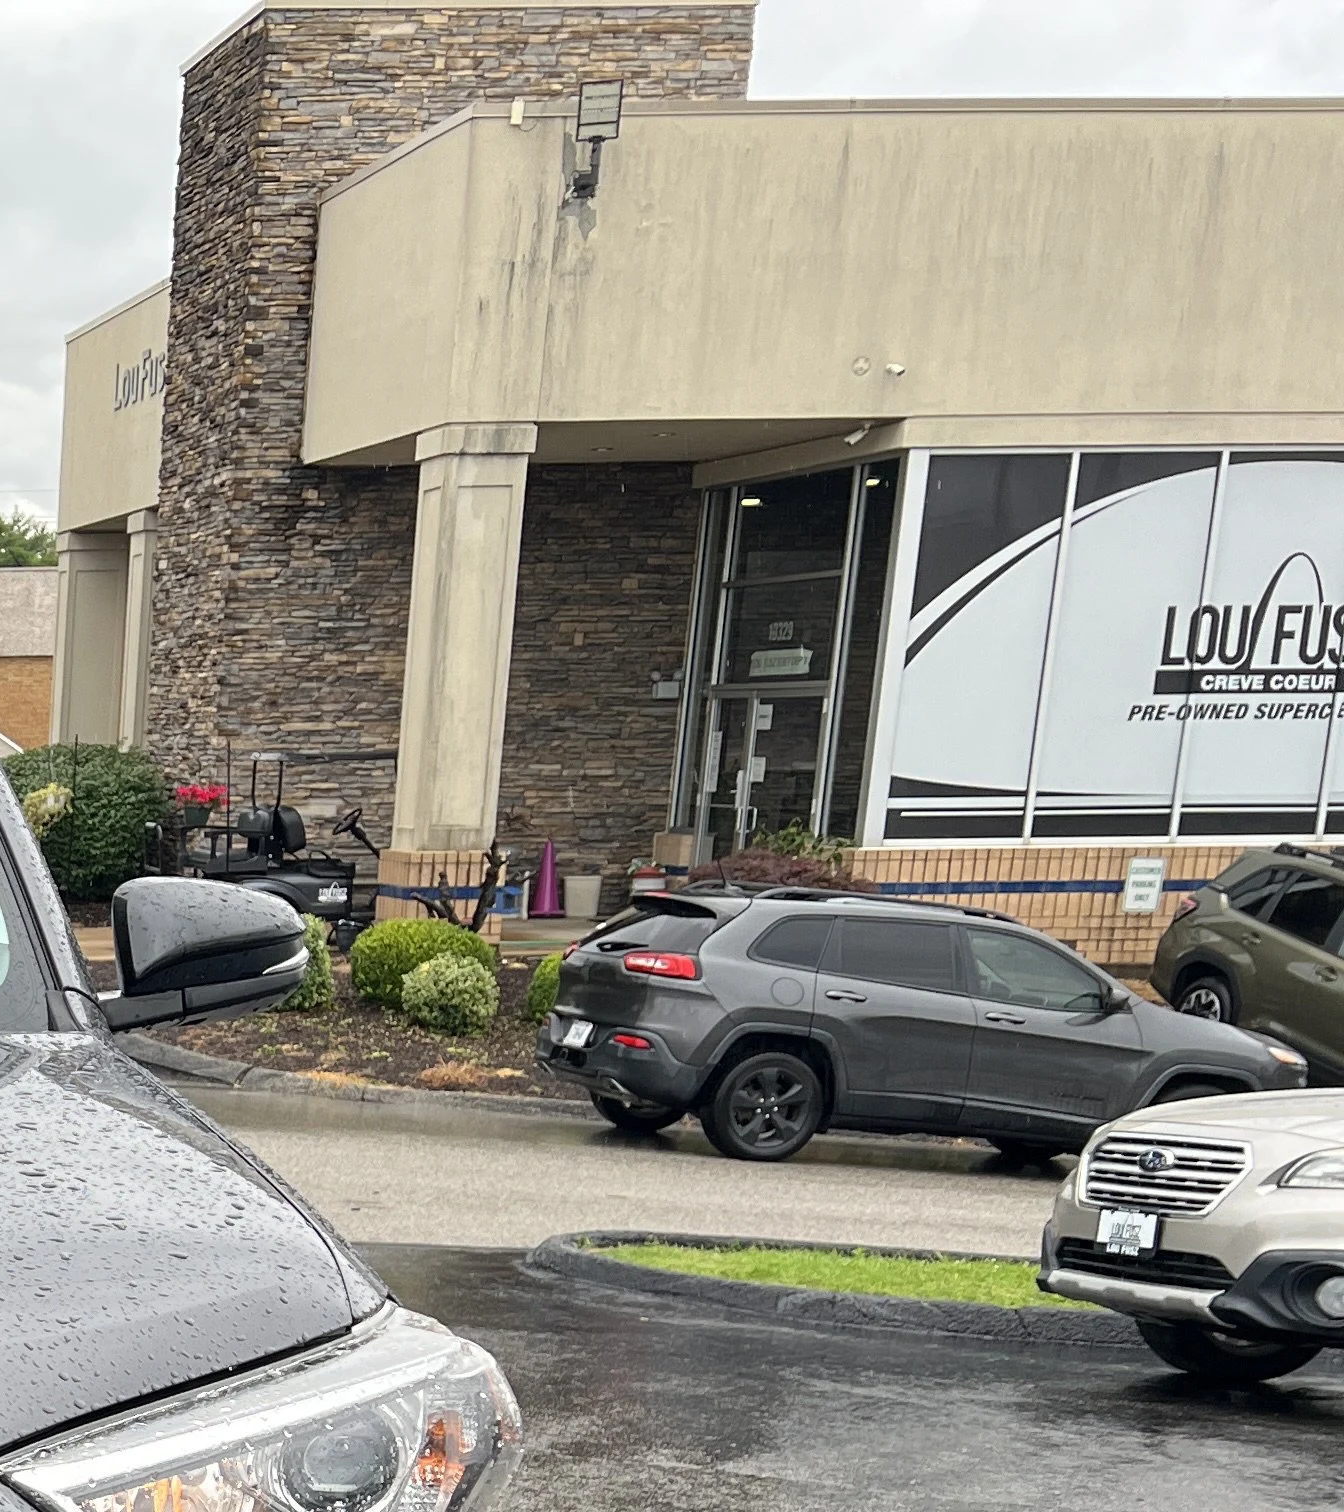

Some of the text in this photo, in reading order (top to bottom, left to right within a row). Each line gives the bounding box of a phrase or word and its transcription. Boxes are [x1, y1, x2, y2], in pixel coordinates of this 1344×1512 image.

[1161, 604, 1252, 666] LOU
[1200, 674, 1337, 691] CREVE COEUR
[1127, 703, 1250, 721] PRE-OWNED
